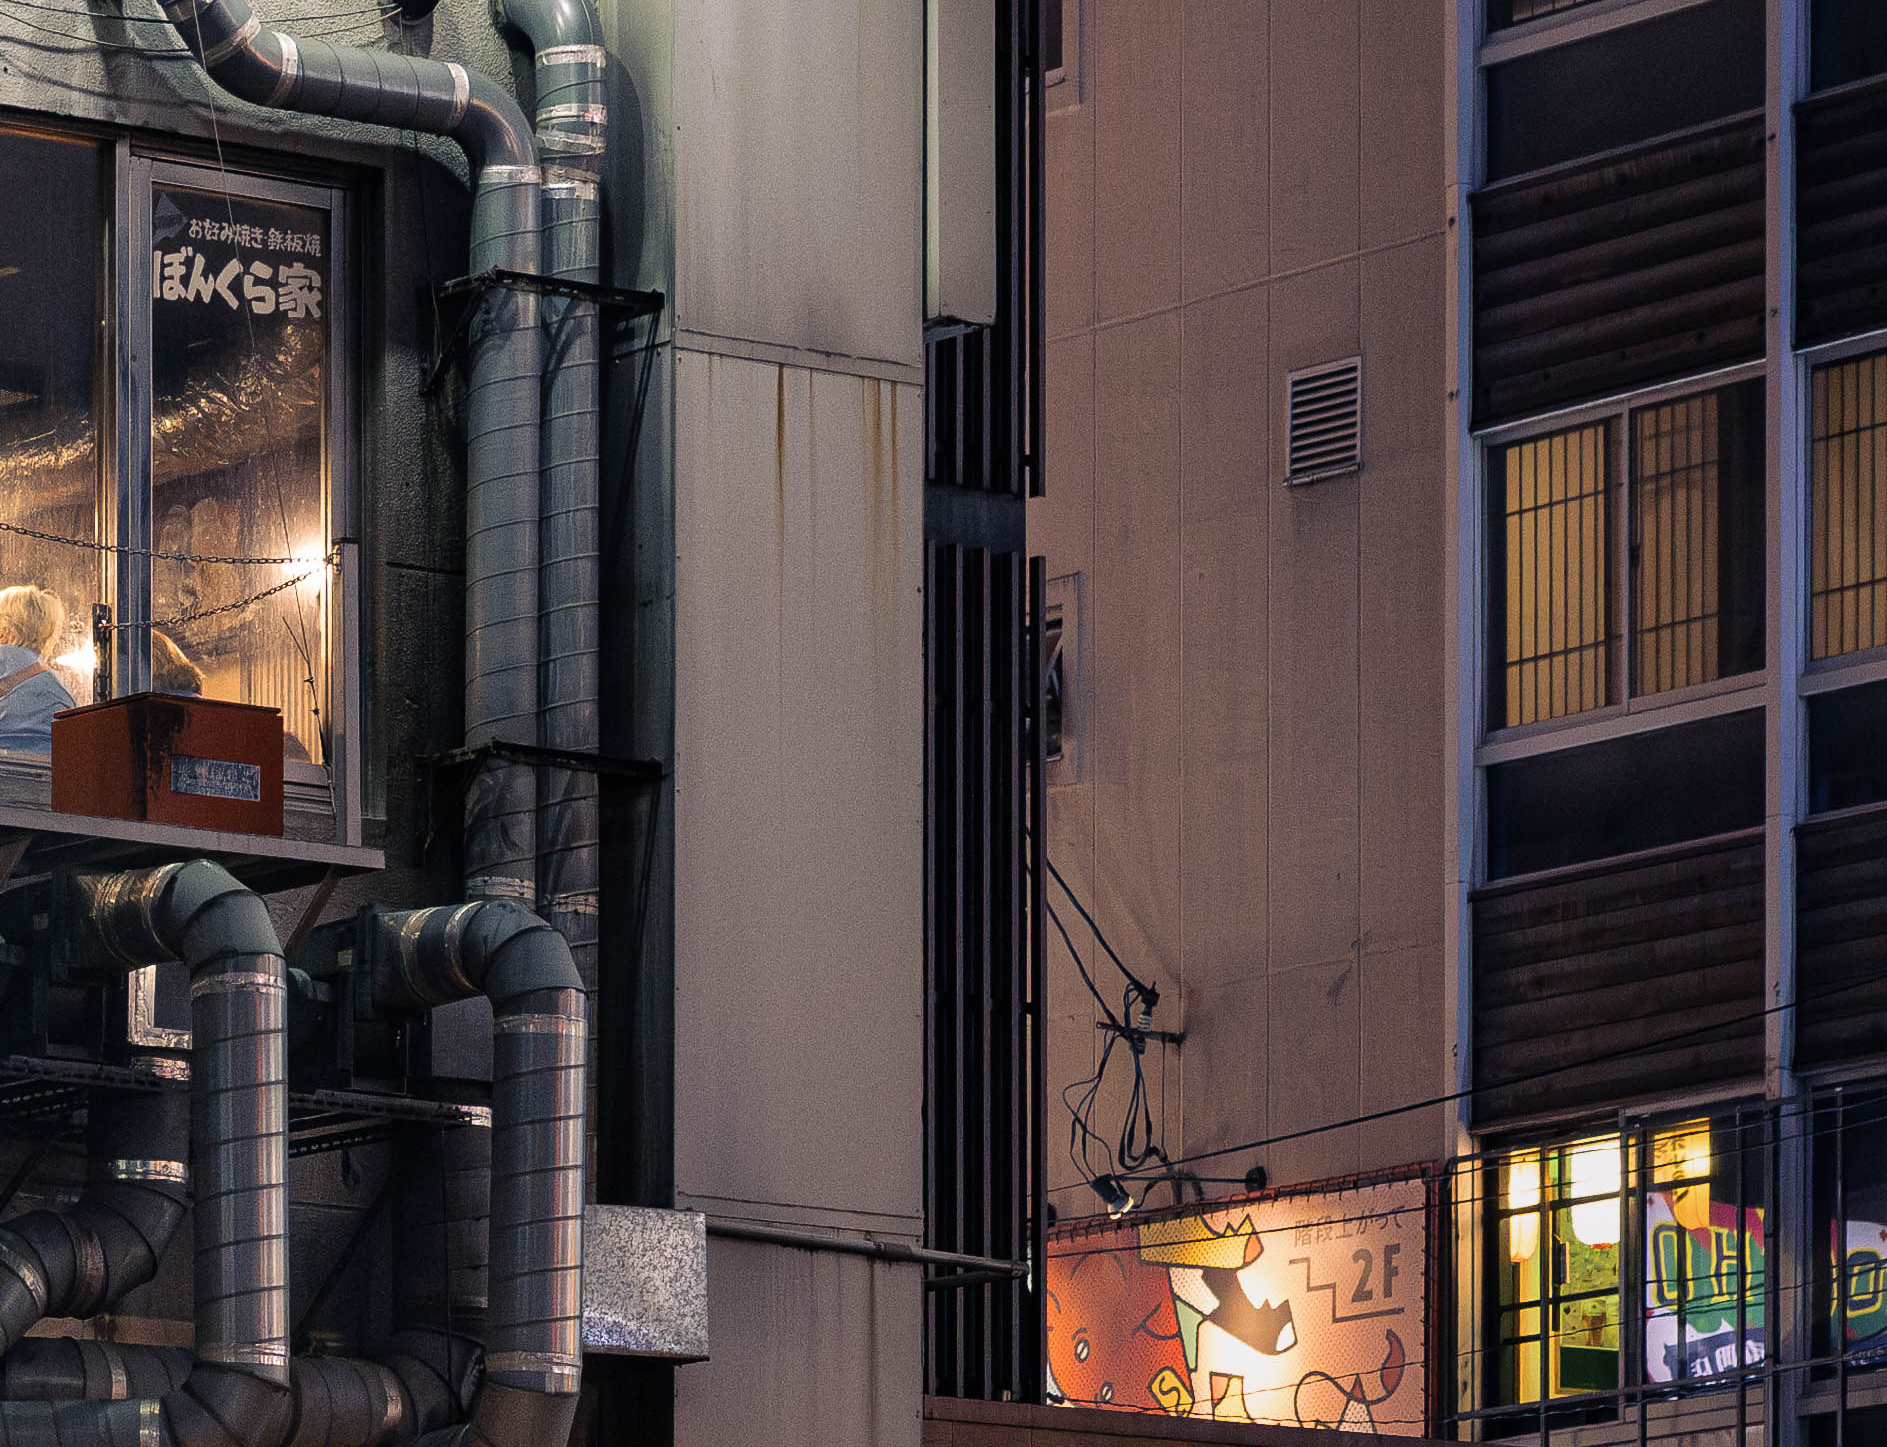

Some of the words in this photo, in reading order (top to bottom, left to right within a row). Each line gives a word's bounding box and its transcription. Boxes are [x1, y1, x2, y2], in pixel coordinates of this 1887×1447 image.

[153, 246, 322, 318] ぼんくら家
[1294, 1205, 1406, 1247] 階段上がって
[1351, 1242, 1402, 1304] 2F
